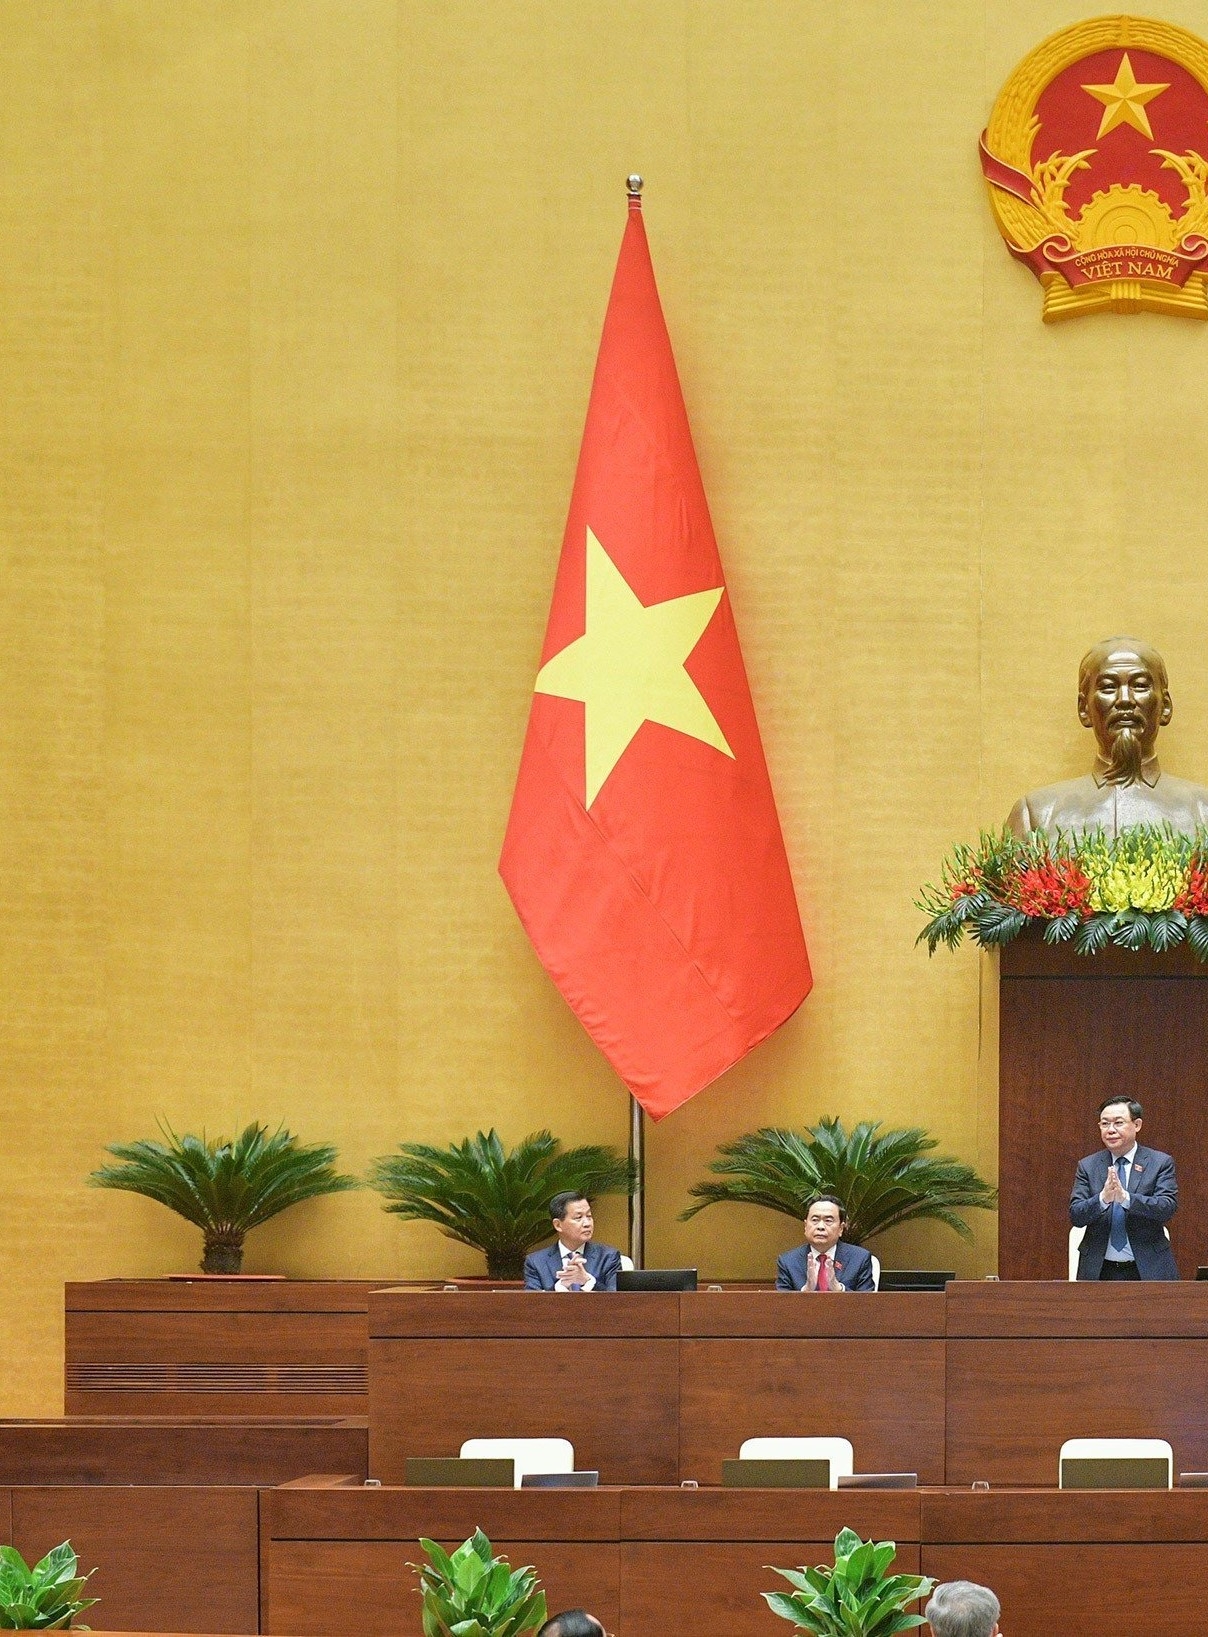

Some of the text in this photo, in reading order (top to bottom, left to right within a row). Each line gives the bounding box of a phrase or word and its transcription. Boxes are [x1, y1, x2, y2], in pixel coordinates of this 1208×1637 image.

[1075, 247, 1179, 268] CỘNG HÒA XÃ HỘI CHỦ NGHĨA
[1081, 261, 1174, 280] VIỆT NAM
